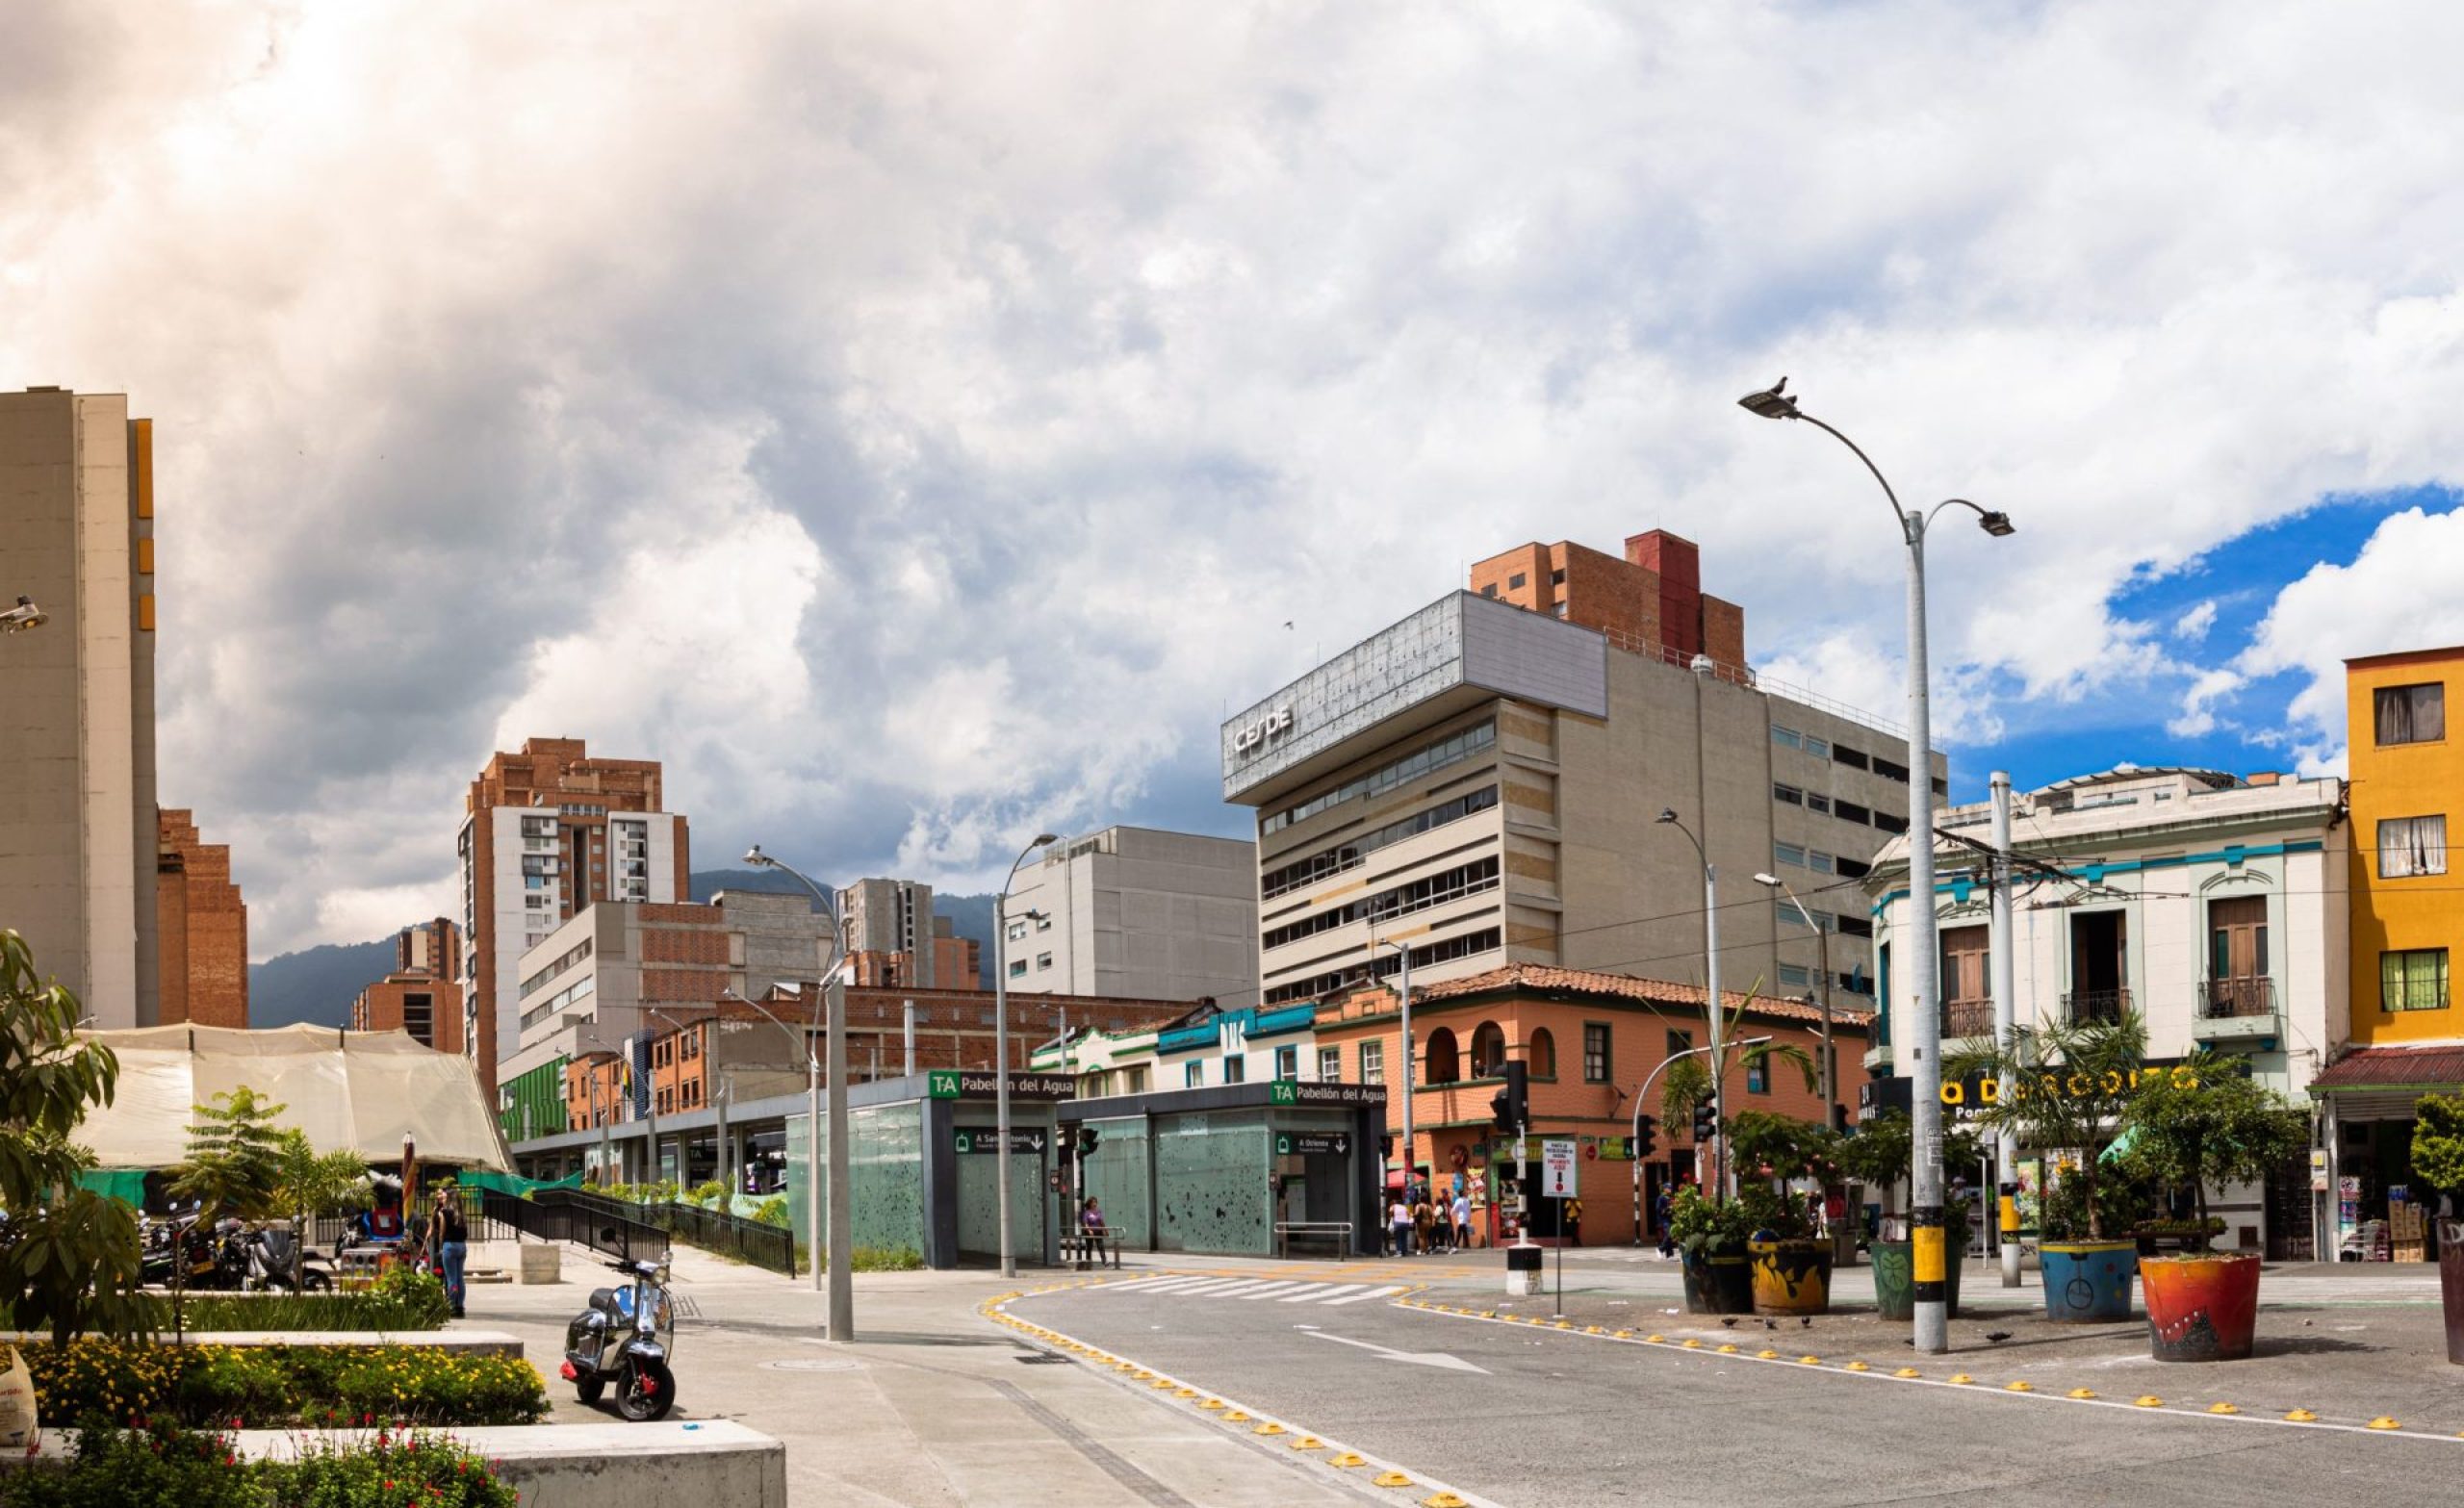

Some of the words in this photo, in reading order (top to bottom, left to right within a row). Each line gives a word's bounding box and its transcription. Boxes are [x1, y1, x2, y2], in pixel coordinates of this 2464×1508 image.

[1235, 704, 1291, 752] CESDE
[962, 1077, 1015, 1091] Pabeln
[1019, 1079, 1039, 1091] del
[1042, 1079, 1074, 1095] Agua
[1296, 1086, 1340, 1099] Pabellón
[1343, 1087, 1358, 1100] del
[1361, 1088, 1386, 1103] Agua
